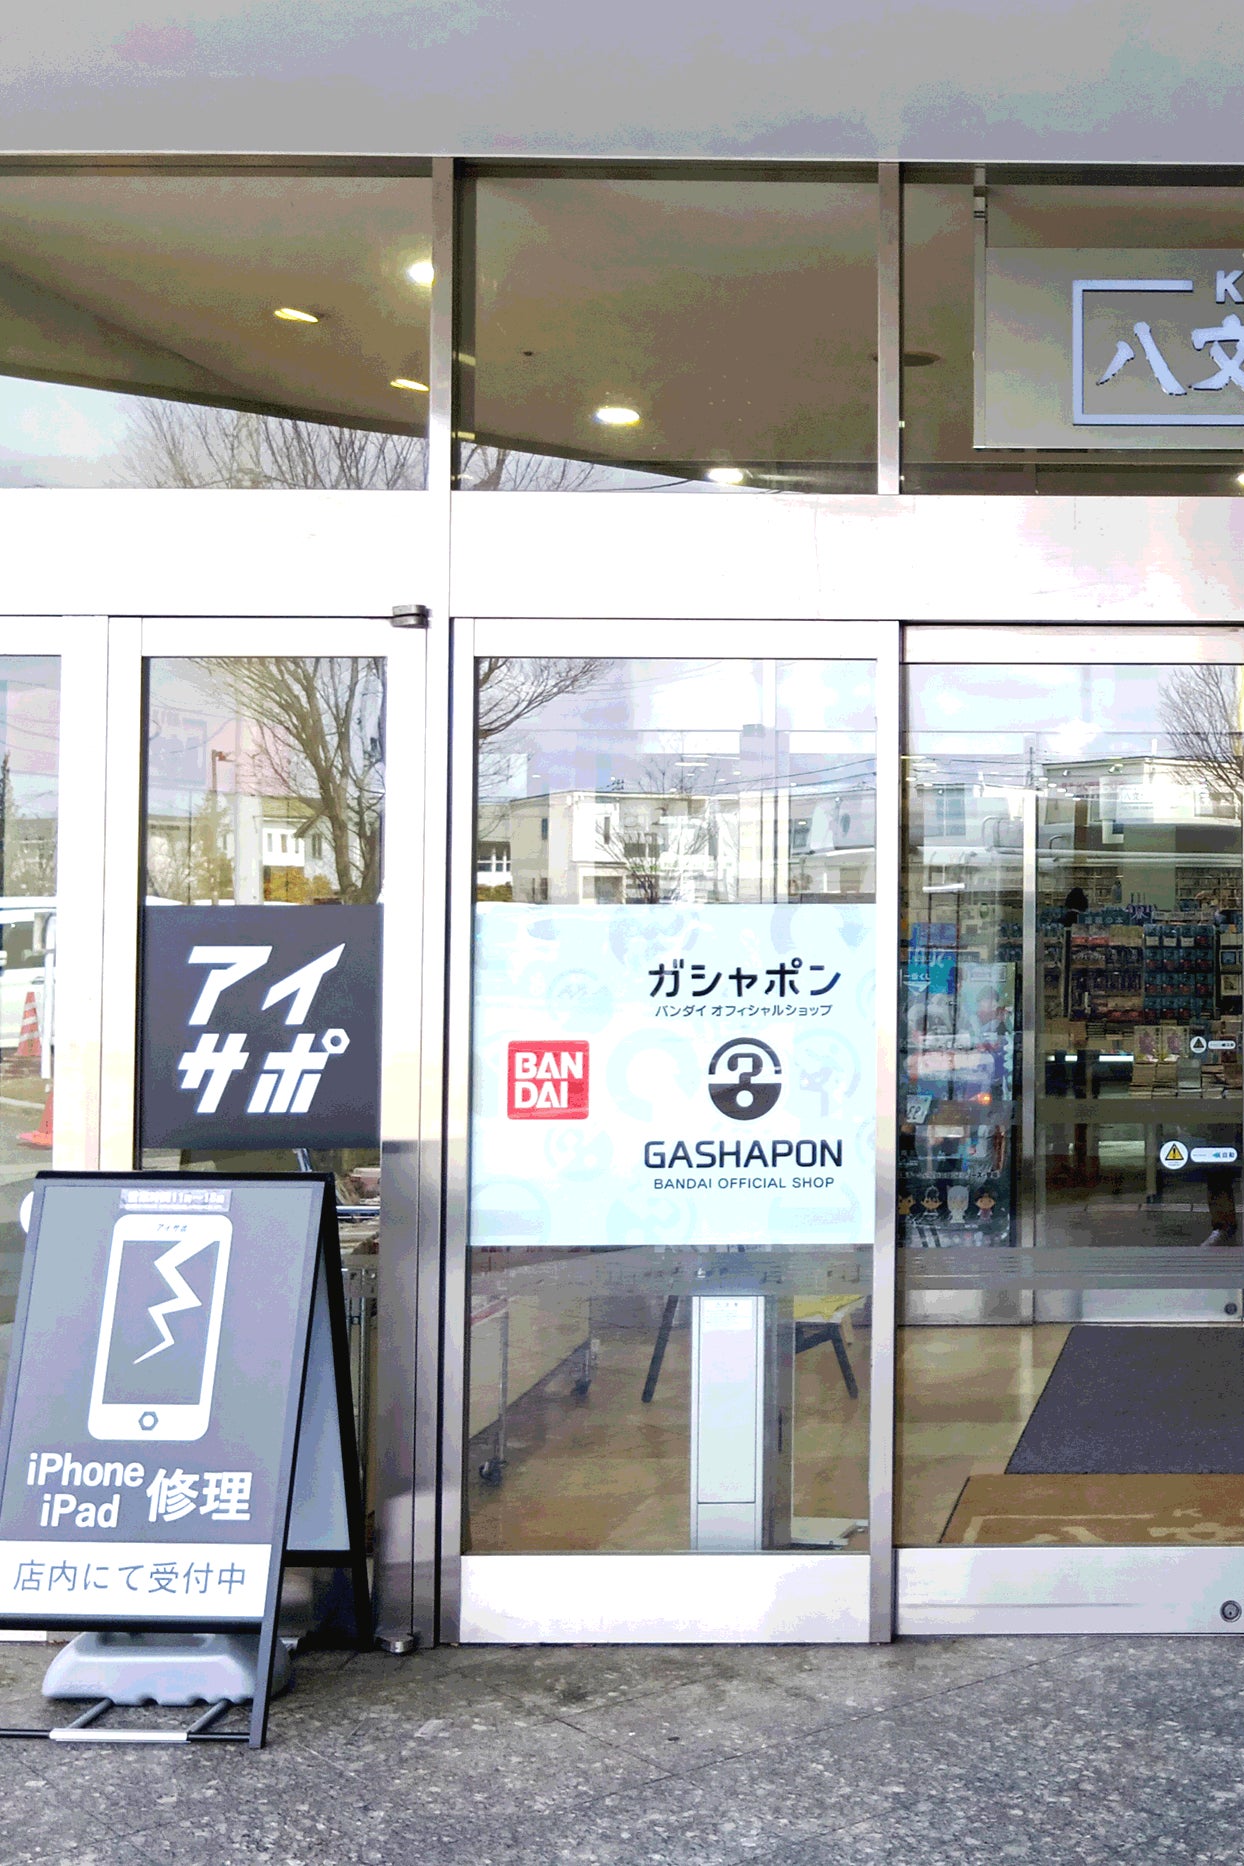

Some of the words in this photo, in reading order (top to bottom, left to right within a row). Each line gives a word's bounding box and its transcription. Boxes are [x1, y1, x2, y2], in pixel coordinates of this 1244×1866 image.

[648, 957, 842, 998] ガシャポン
[655, 1005, 705, 1017] バンダイ
[711, 1004, 833, 1018] オフィシャルショップ
[177, 1028, 351, 1115] サポ
[514, 1051, 584, 1080] BAN
[514, 1082, 568, 1109] DAI
[644, 1140, 843, 1168] GASHAPON
[653, 1178, 713, 1189] BANDAI
[717, 1177, 787, 1189] OFFICIAL
[791, 1177, 834, 1188] SHOP
[27, 1452, 145, 1488] iPhone
[40, 1494, 121, 1529] iPad
[146, 1468, 253, 1522] 修理
[13, 1559, 246, 1595] 店内にて受付中
